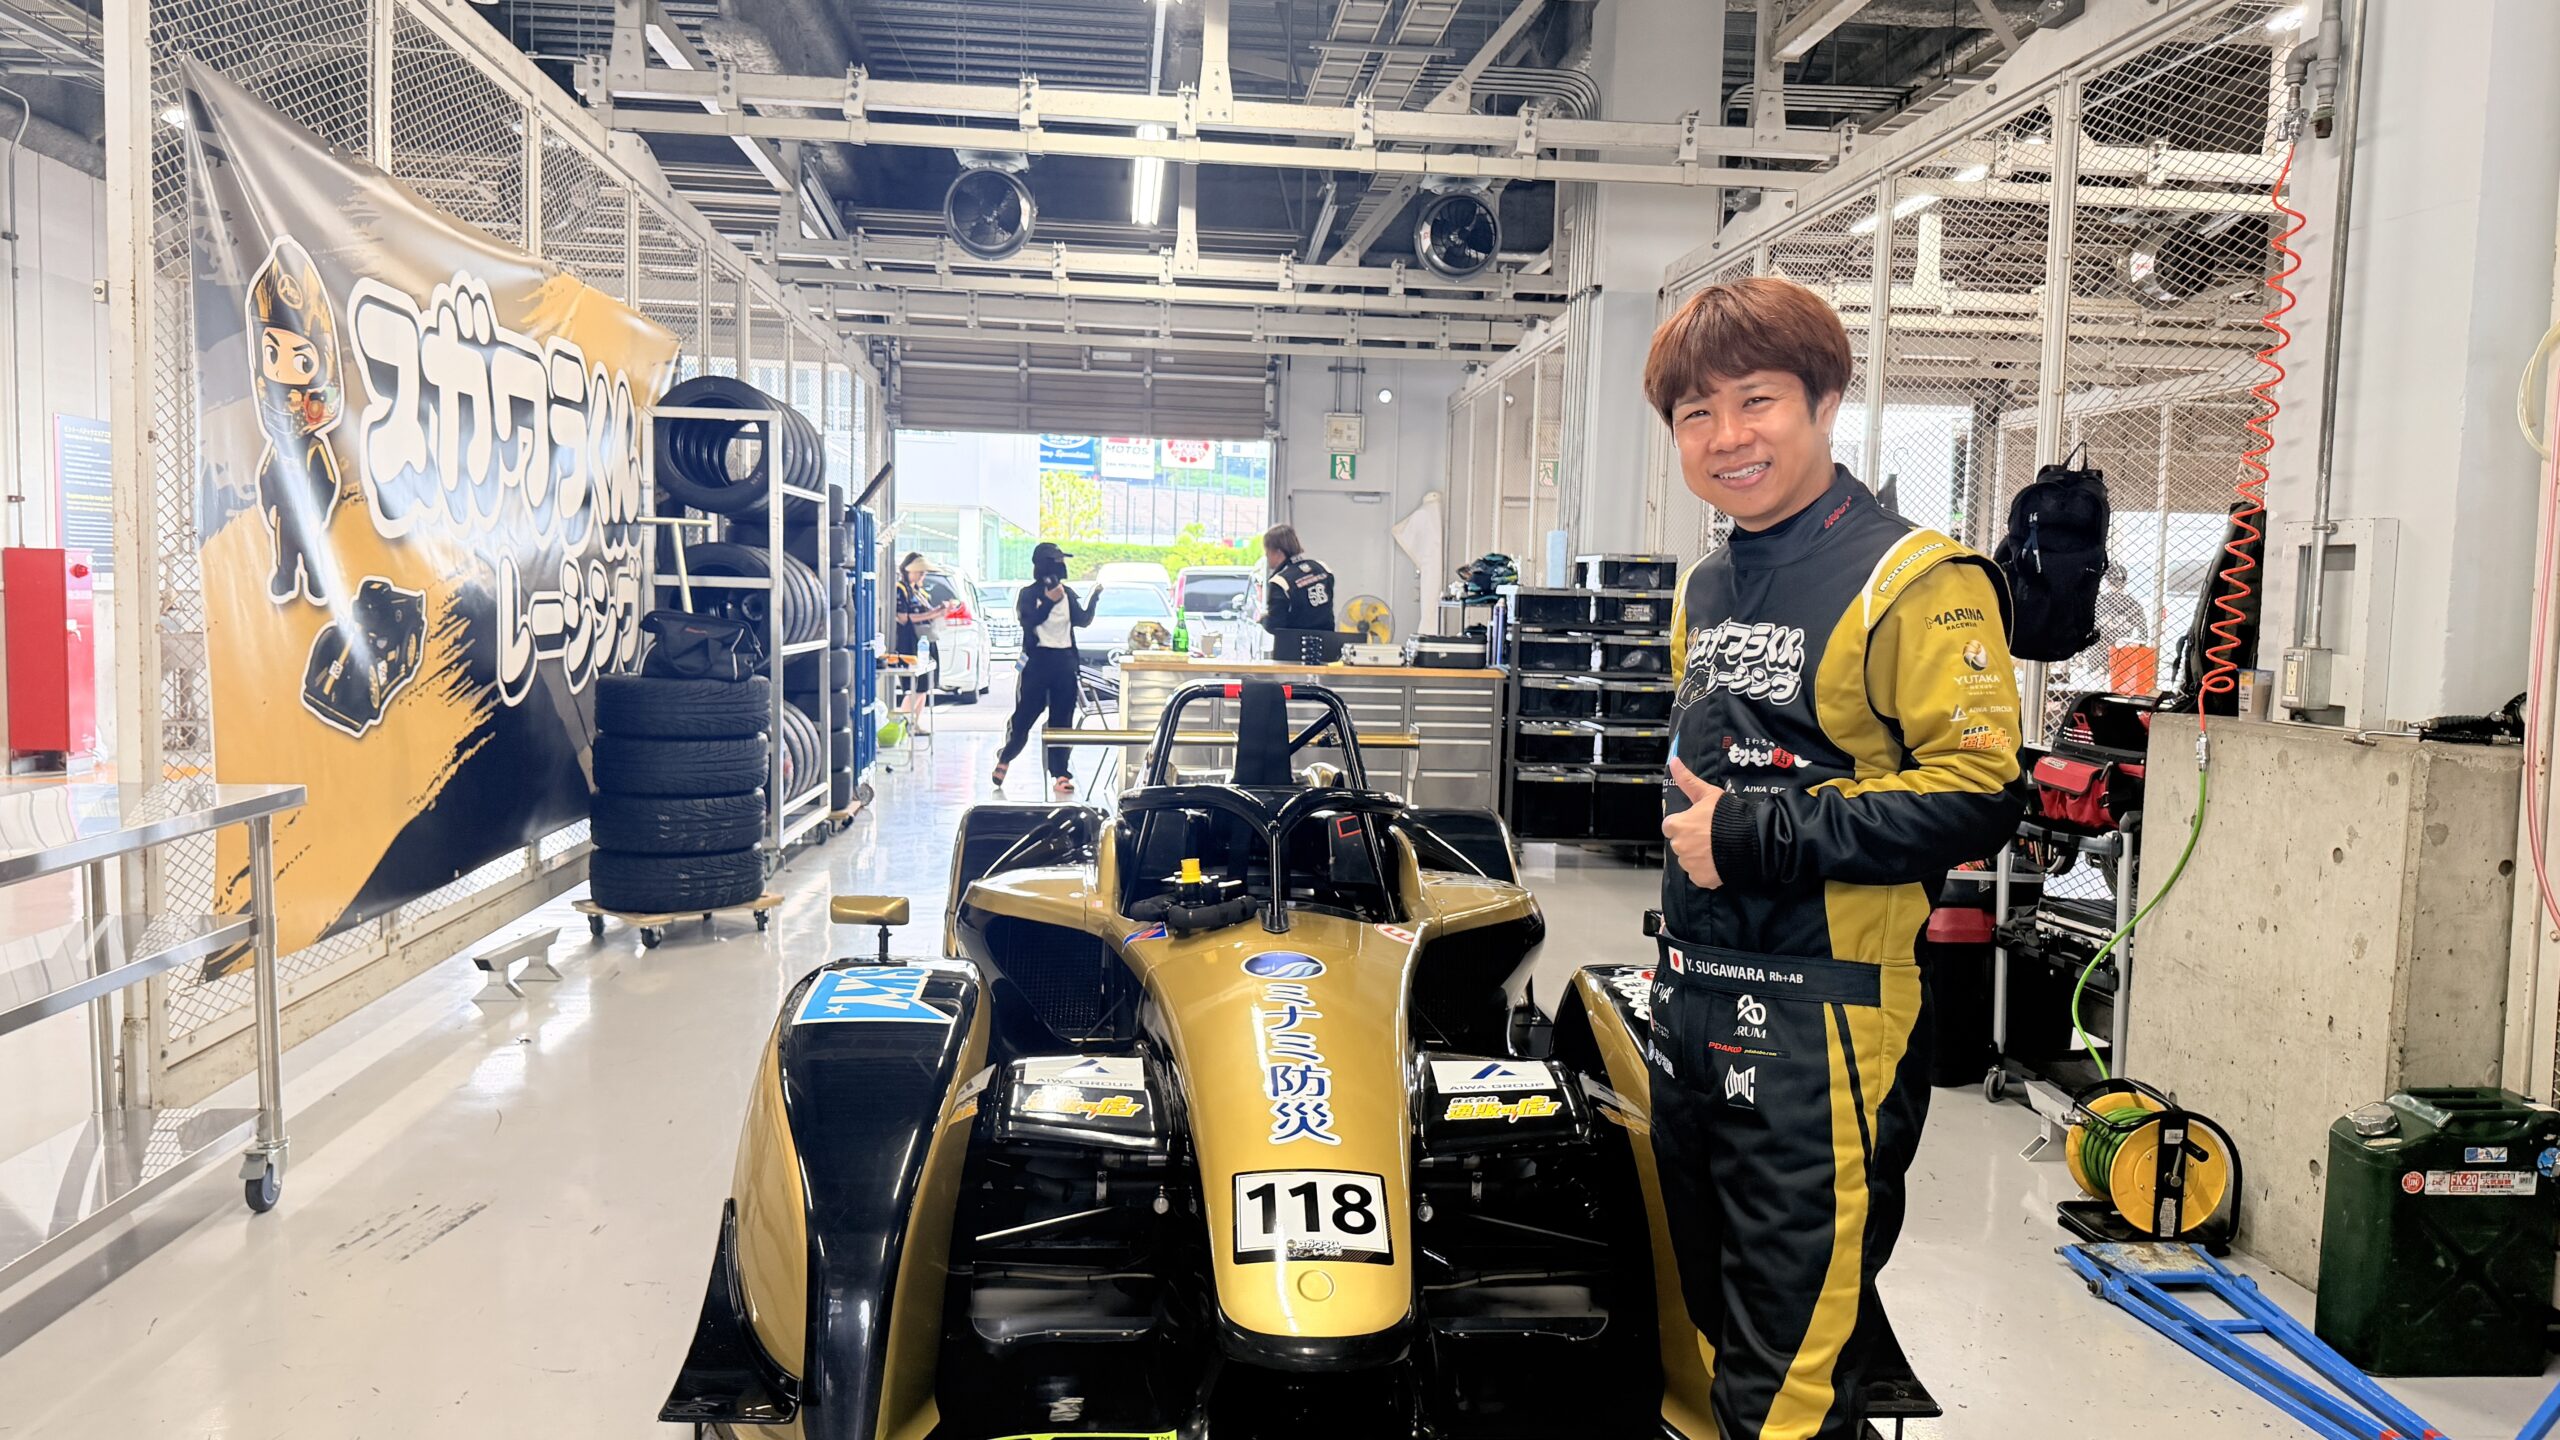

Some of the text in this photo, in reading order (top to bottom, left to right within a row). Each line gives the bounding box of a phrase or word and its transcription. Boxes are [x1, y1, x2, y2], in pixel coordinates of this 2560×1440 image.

[350, 276, 641, 550] スガワラくん
[498, 549, 641, 700] レーシング
[1925, 607, 1985, 630] MARINA
[1953, 674, 2000, 685] YUTAKA
[1742, 785, 1767, 793] AIWA
[1685, 957, 1804, 984] Y. SUGAWARA Rh+AB
[1733, 1025, 1767, 1039] ARUM
[1264, 983, 1338, 1142] ミナミ防災
[1036, 1077, 1134, 1087] AIWA GROUP
[1246, 1181, 1377, 1235] 118
